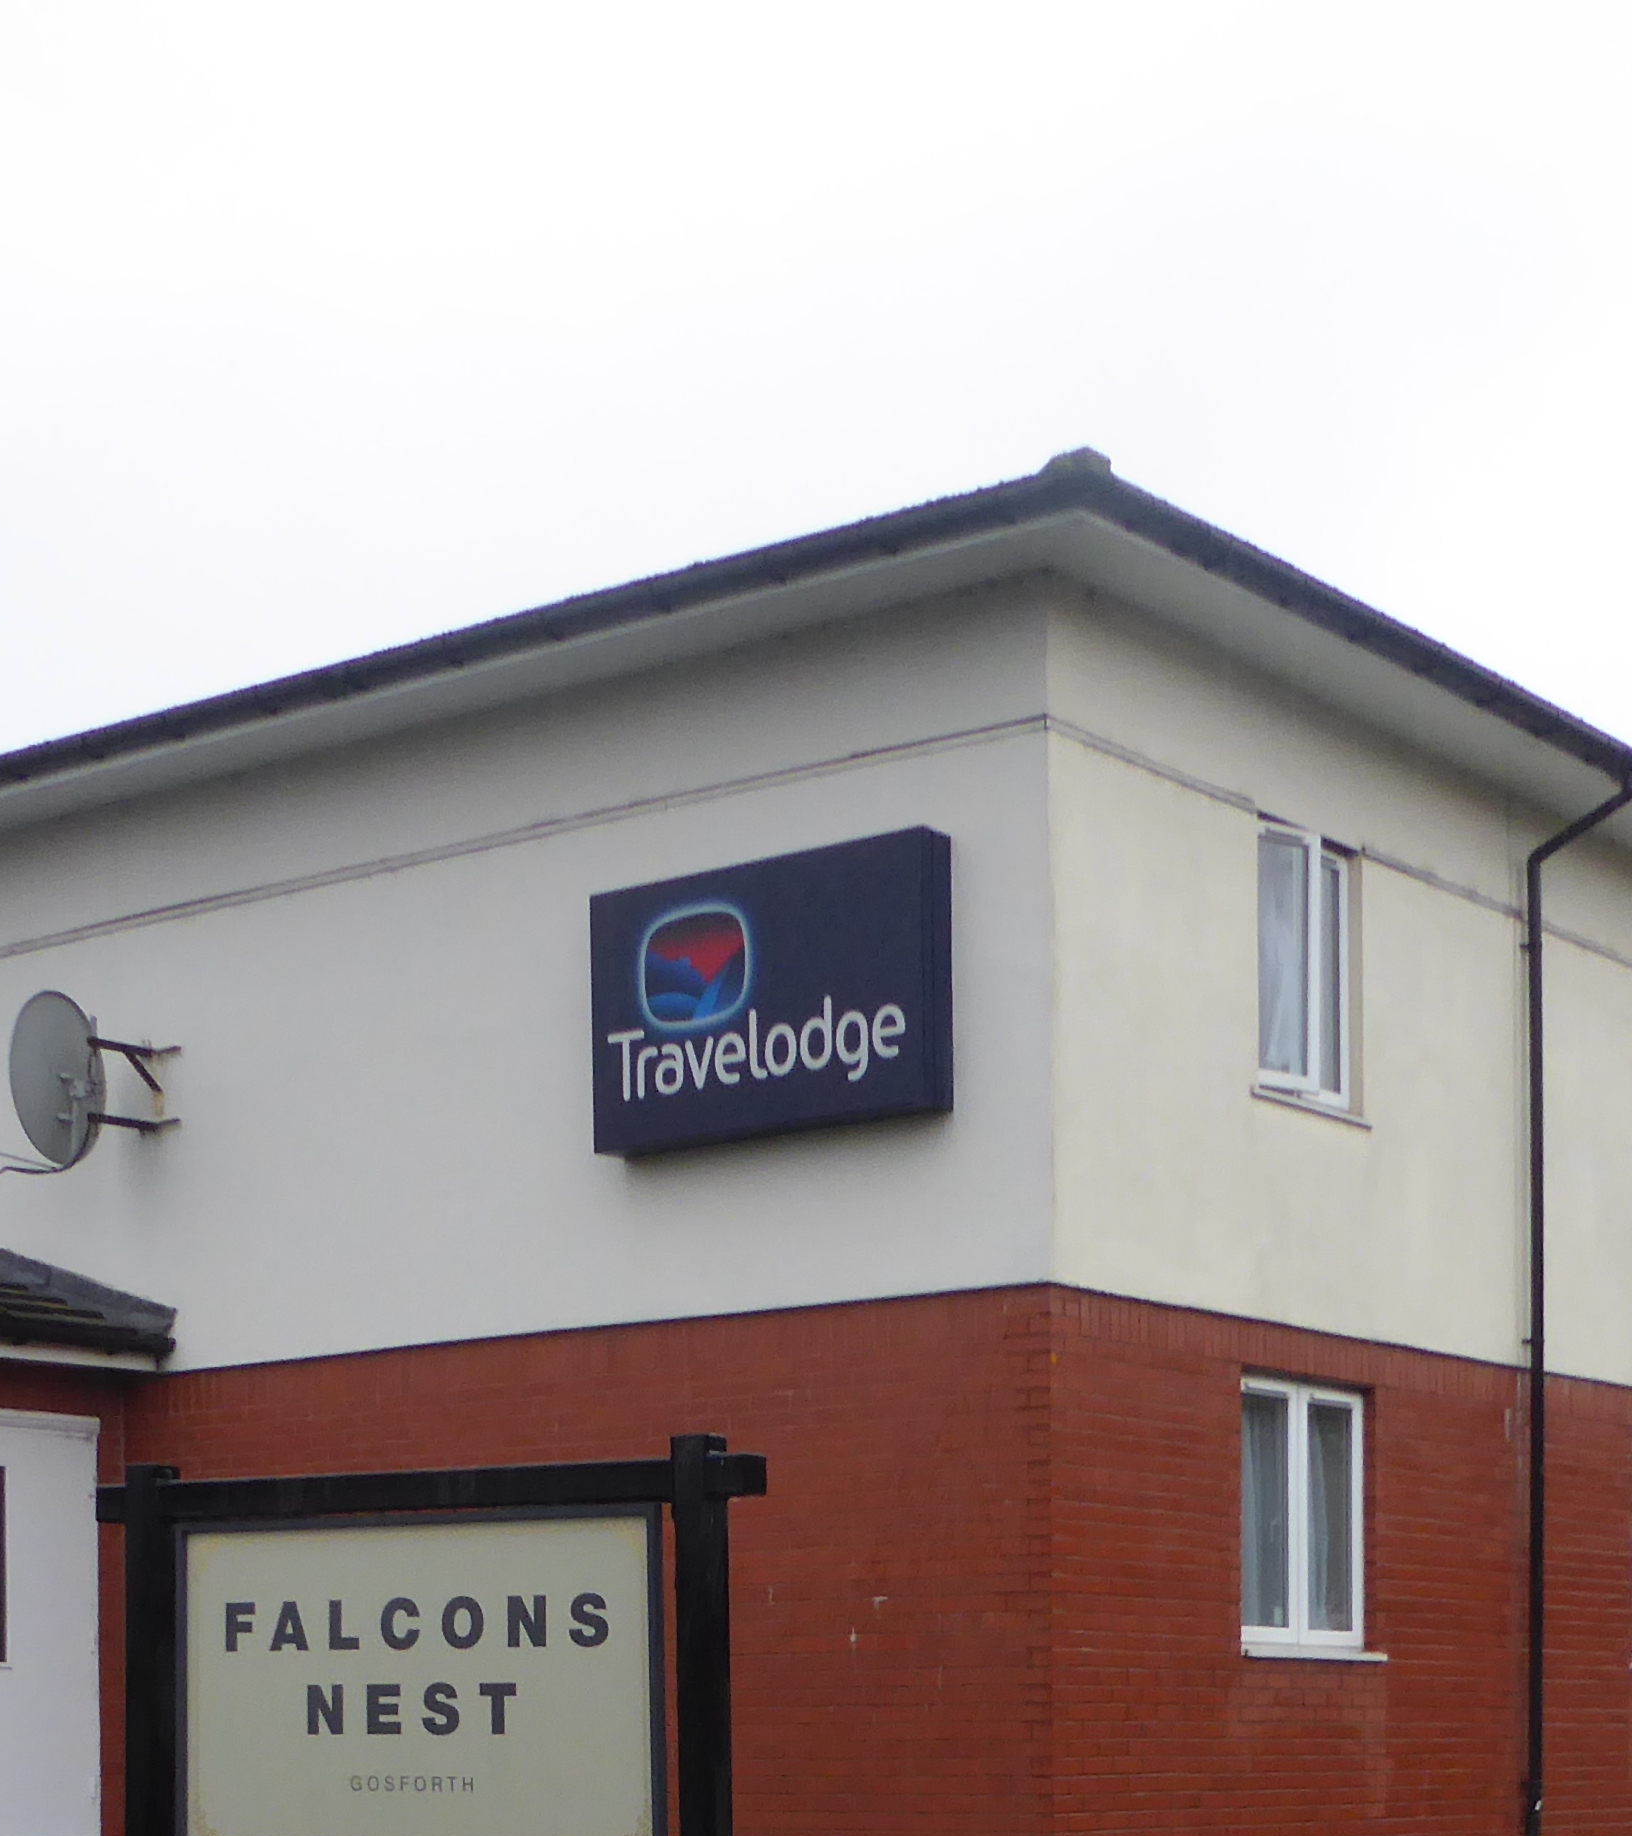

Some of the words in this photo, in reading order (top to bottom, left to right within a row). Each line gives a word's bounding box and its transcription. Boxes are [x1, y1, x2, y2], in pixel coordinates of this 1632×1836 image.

[607, 994, 906, 1102] Travelodge
[224, 1592, 610, 1652] FALCONS
[306, 1682, 517, 1735] NEST
[349, 1775, 475, 1793] GOSFORTH
